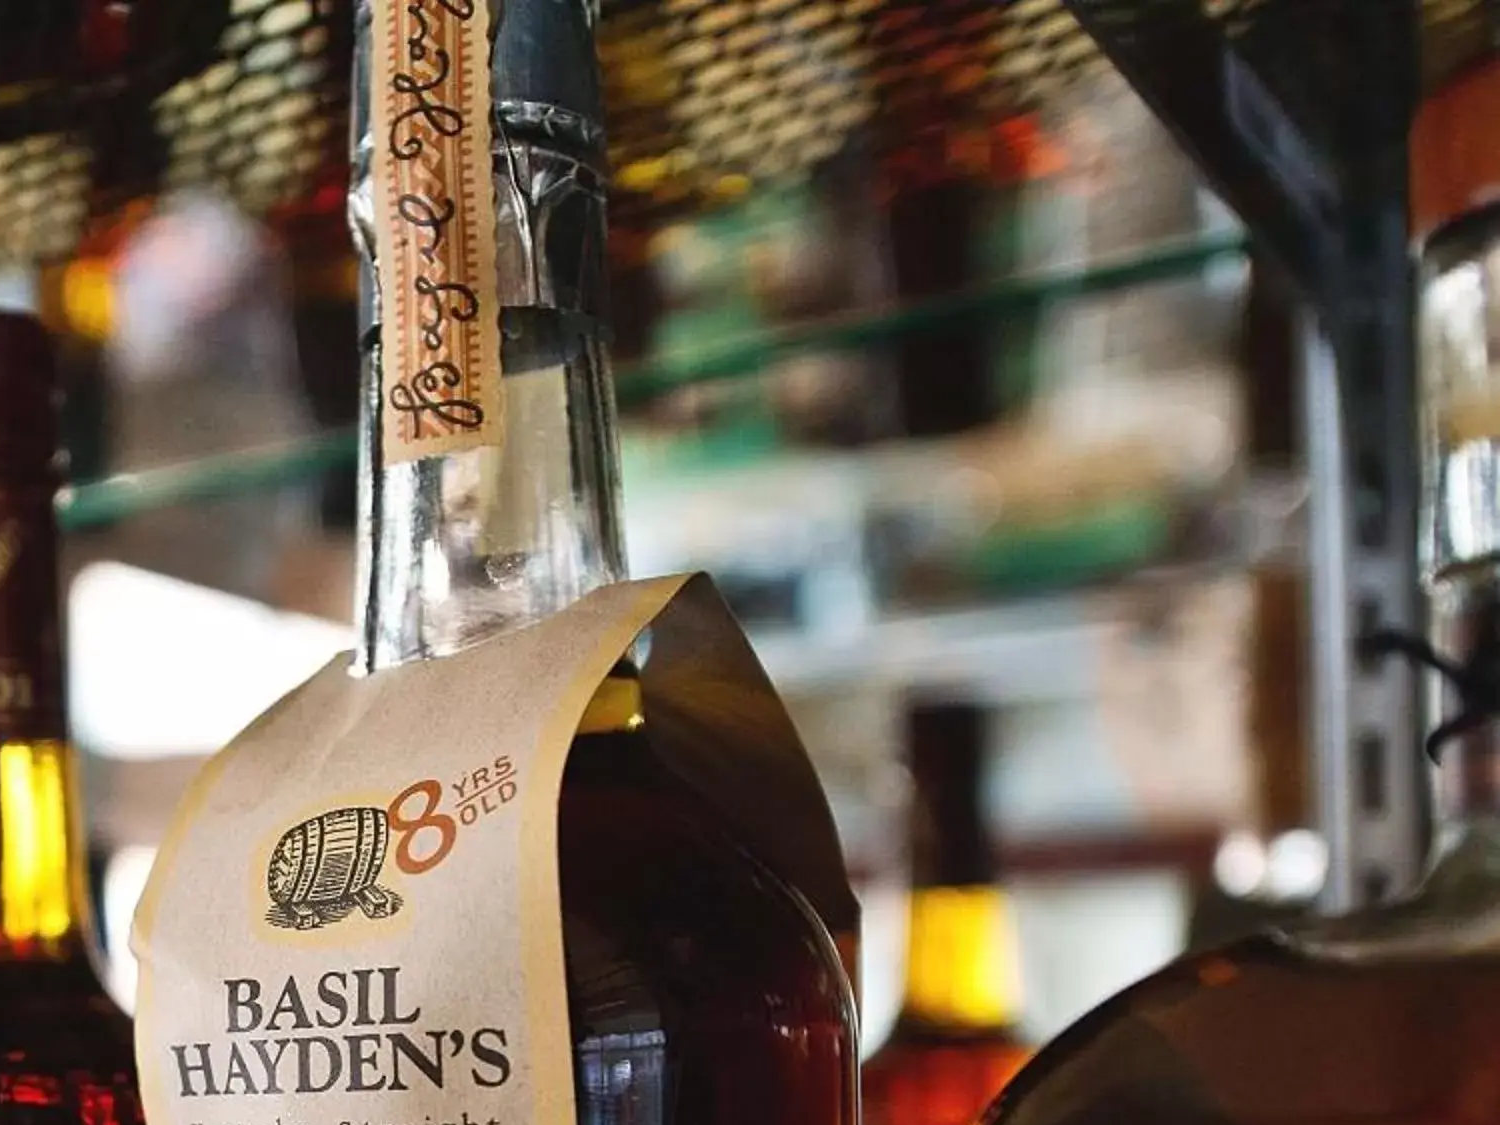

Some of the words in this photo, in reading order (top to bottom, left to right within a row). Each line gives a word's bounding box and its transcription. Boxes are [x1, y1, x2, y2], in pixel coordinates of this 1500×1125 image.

[387, 779, 457, 875] 8
[451, 755, 514, 798] YRS
[459, 780, 518, 826] OLD
[224, 967, 420, 1033] BASIL
[171, 1028, 511, 1098] HAYDEN'S
